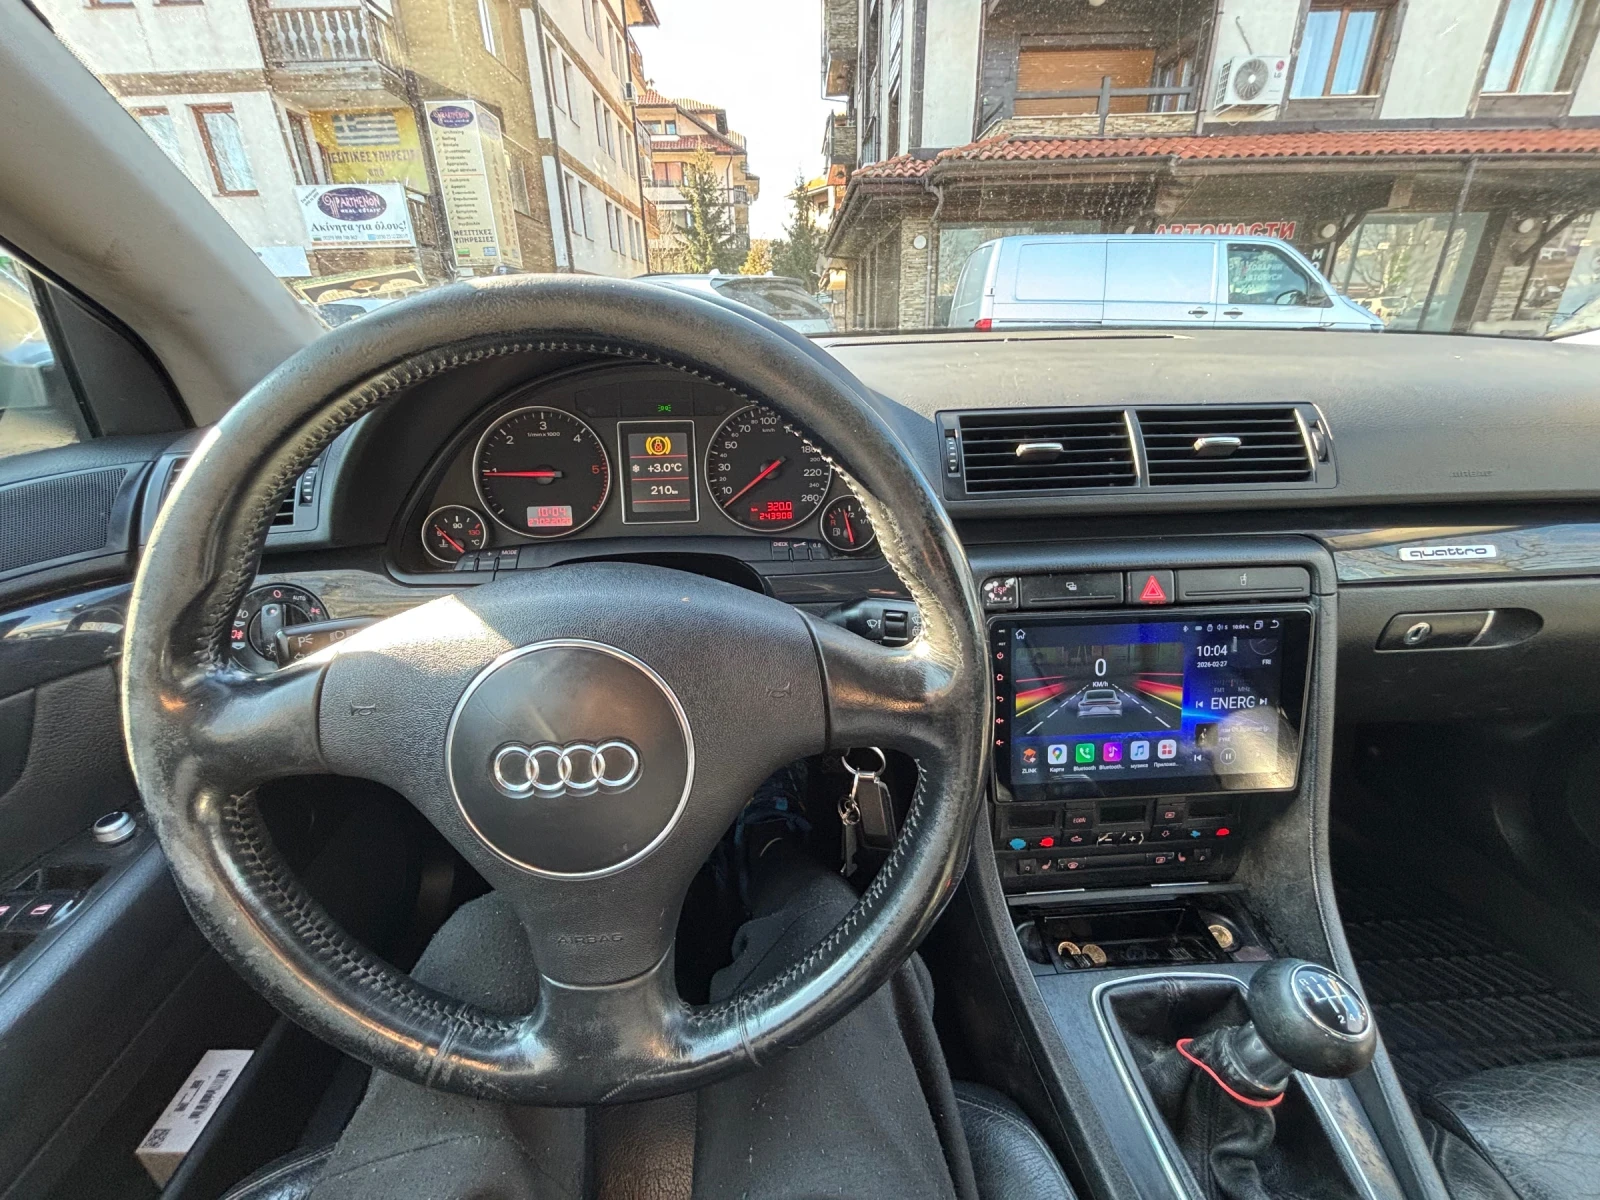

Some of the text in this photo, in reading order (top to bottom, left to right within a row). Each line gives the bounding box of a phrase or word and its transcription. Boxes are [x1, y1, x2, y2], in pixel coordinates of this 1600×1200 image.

[1154, 220, 1297, 240] АВТОЧАСТИ
[760, 417, 777, 425] 100
[539, 422, 547, 430] 3
[738, 424, 751, 433] 70
[506, 436, 514, 445] 2
[573, 434, 582, 443] 4
[724, 441, 738, 449] 50
[591, 466, 600, 474] 5
[648, 463, 682, 473] +3.0°C
[718, 463, 731, 471] 30
[803, 468, 822, 477] 220
[722, 486, 732, 494] 10
[801, 494, 820, 502] 260
[759, 512, 793, 520] 243908
[1409, 546, 1488, 560] quattro
[1196, 645, 1228, 657] 10:04
[1095, 658, 1107, 677] 0
[1210, 695, 1256, 710] ENERG
[557, 932, 623, 945] AIRBAG
